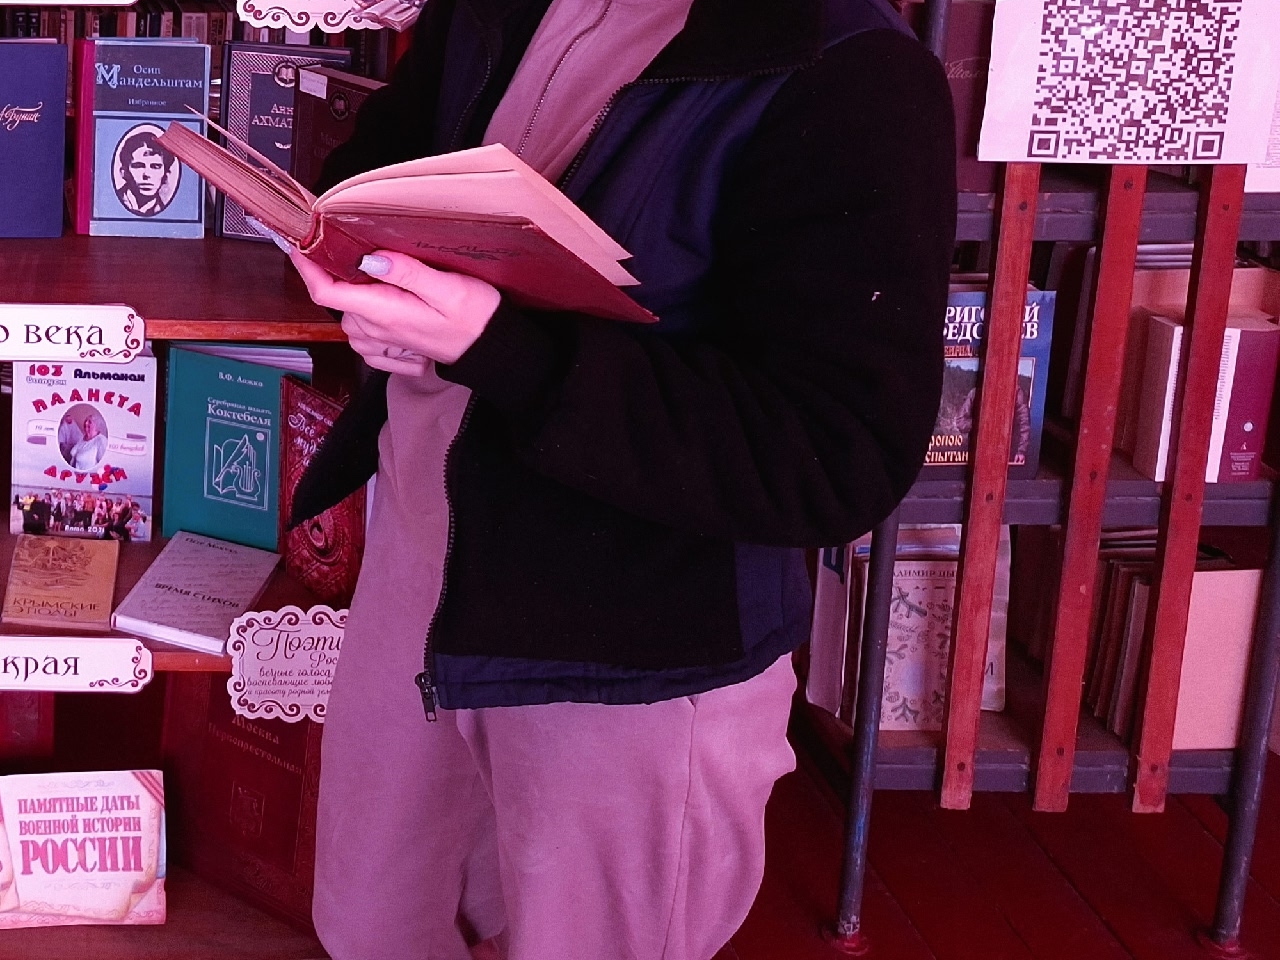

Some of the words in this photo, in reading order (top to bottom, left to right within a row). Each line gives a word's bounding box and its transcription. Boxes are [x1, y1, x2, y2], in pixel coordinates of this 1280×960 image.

[95, 62, 204, 88] Мандельштам
[133, 65, 161, 76] Осип
[270, 104, 294, 115] Анн
[24, 319, 105, 352] века
[74, 368, 146, 383] Альманах
[207, 403, 271, 427] Коктебеля
[13, 597, 101, 611] КРЫМСКИЕ
[1, 654, 81, 685] края
[18, 797, 97, 815] ПАМЯТНЫЕ
[100, 795, 141, 814] ДАТЫ
[19, 814, 79, 836] ВОЕННОЙ
[82, 815, 142, 833] ИСТОРИИ
[21, 837, 143, 876] РОССИИ
